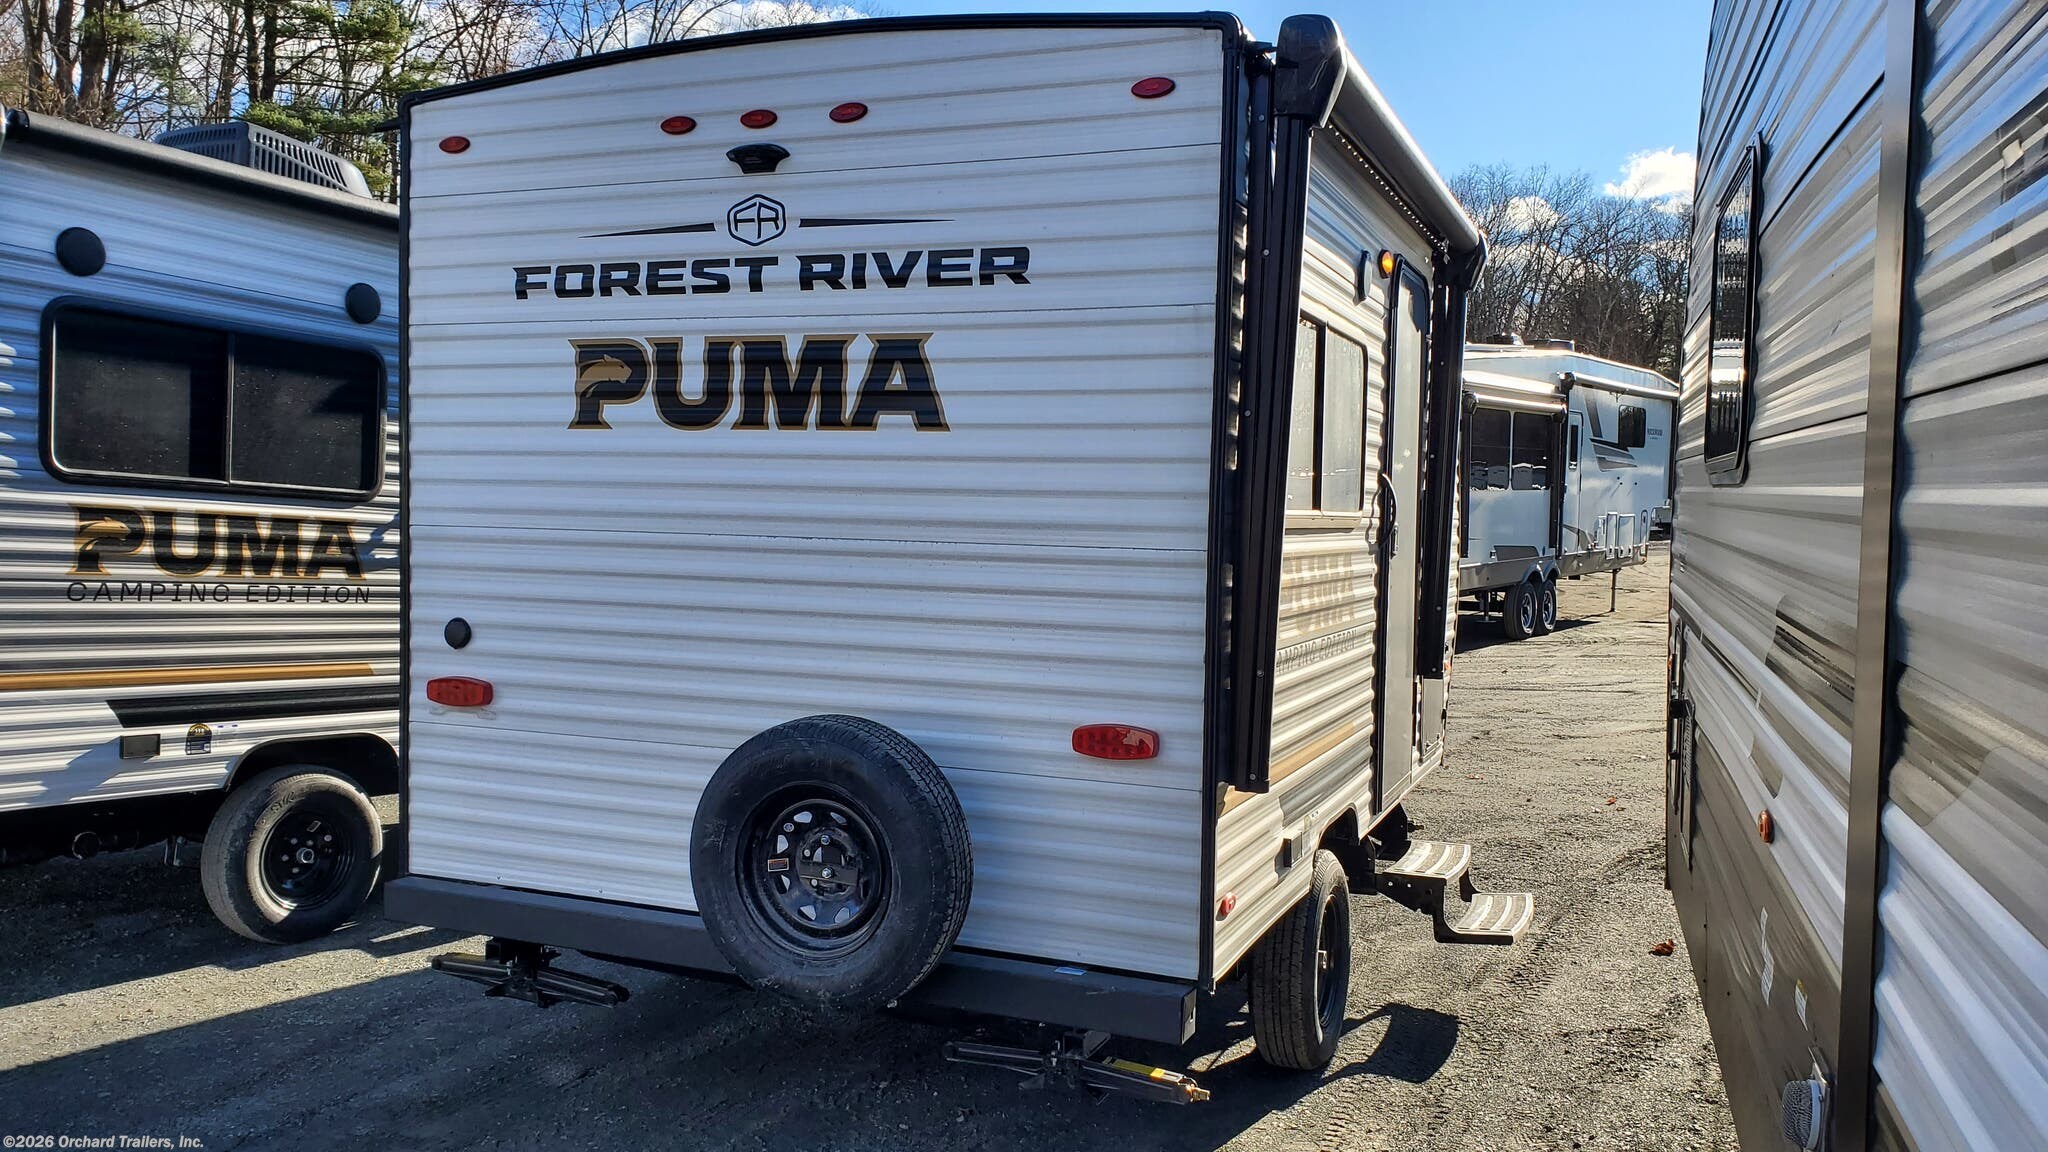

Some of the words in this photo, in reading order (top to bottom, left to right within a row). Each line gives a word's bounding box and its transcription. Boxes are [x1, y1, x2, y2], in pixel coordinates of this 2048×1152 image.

[513, 256, 779, 300] FOREST
[796, 246, 1031, 290] RIVER
[567, 332, 951, 432] PUMA
[66, 502, 367, 580] PUMA
[66, 581, 230, 603] CAMPING
[246, 585, 370, 604] EDITION
[1275, 640, 1318, 674] AMPING
[1320, 629, 1358, 661] EDITION
